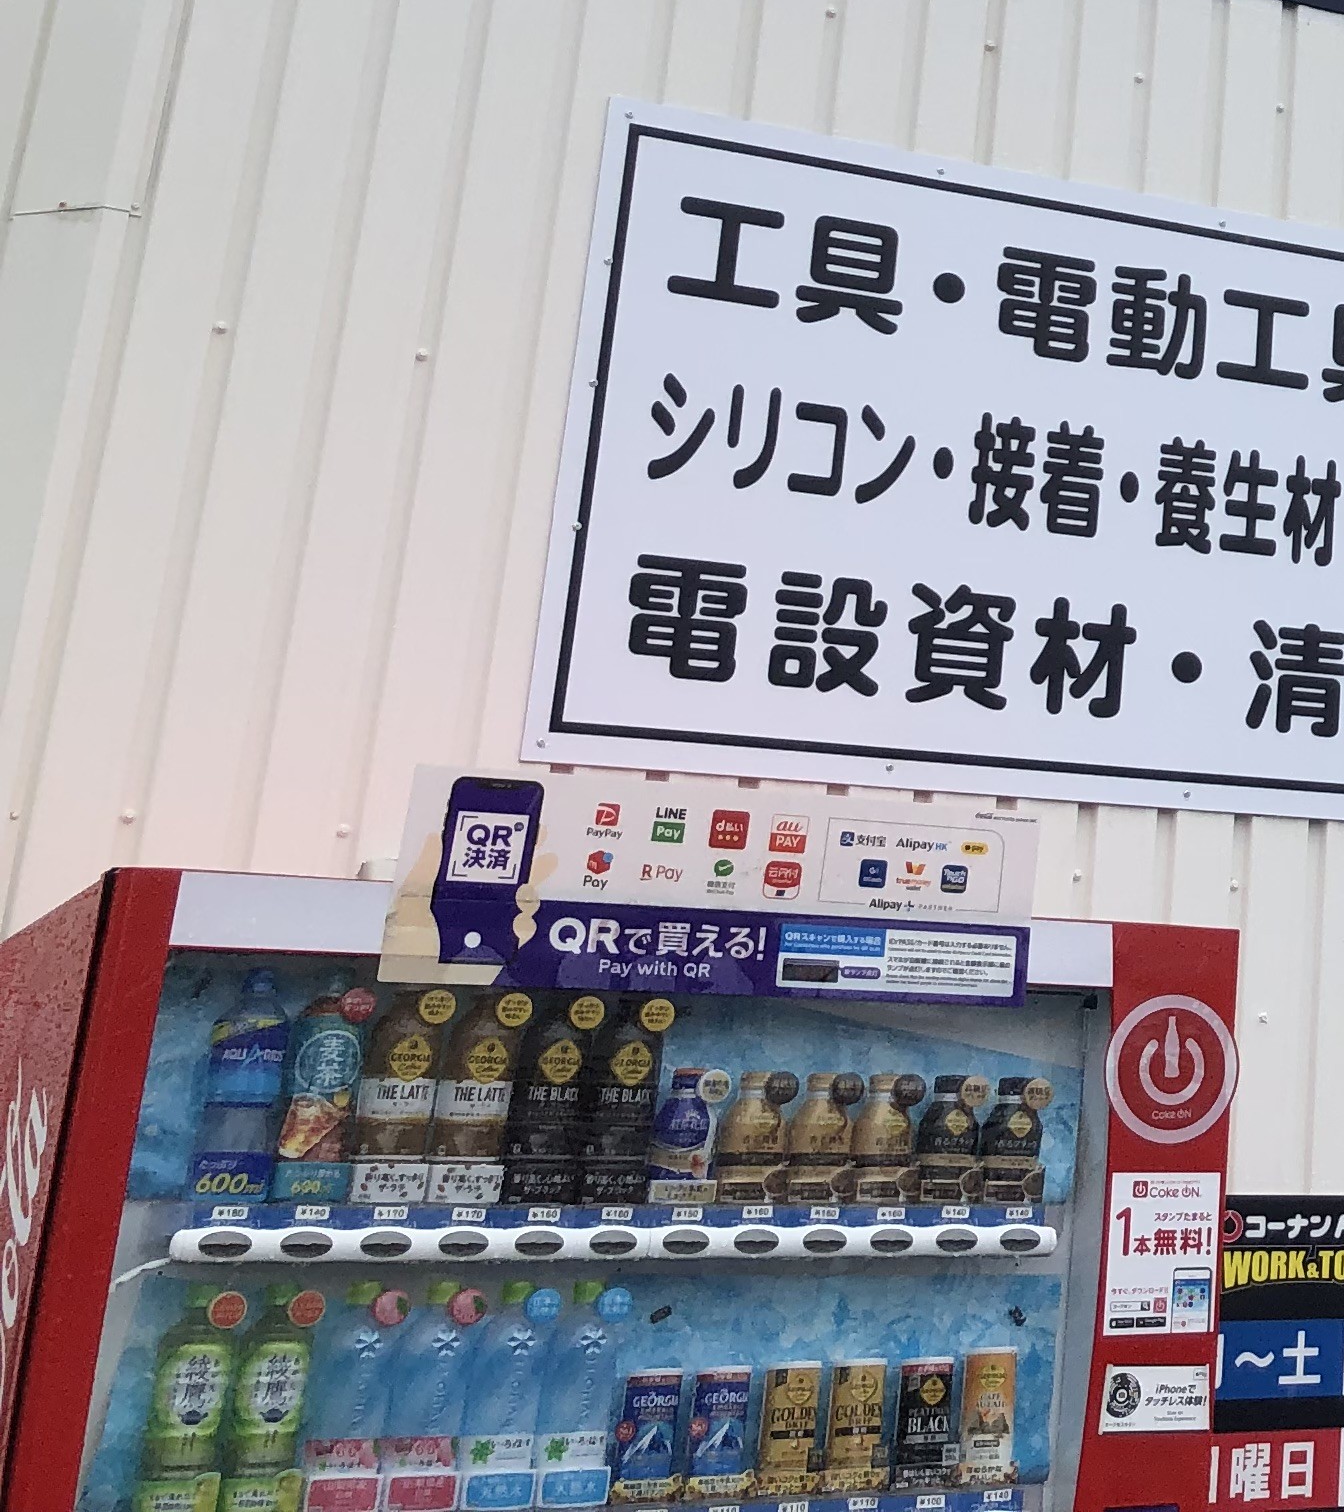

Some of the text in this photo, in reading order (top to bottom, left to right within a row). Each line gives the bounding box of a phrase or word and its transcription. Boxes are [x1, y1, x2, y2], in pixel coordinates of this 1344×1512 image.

[655, 806, 687, 820] LINE
[466, 823, 511, 849] QR
[586, 826, 623, 840] PayPay
[656, 826, 681, 840] Pay
[775, 835, 802, 848] PAY
[463, 847, 510, 871] 決済
[655, 865, 683, 882] Pay
[583, 874, 608, 891] Pay
[598, 959, 712, 979] Pay with QR
[1149, 1186, 1179, 1198] Coke
[1155, 1384, 1197, 1395] iPhoneで
[1208, 1440, 1316, 1505] 曜日
